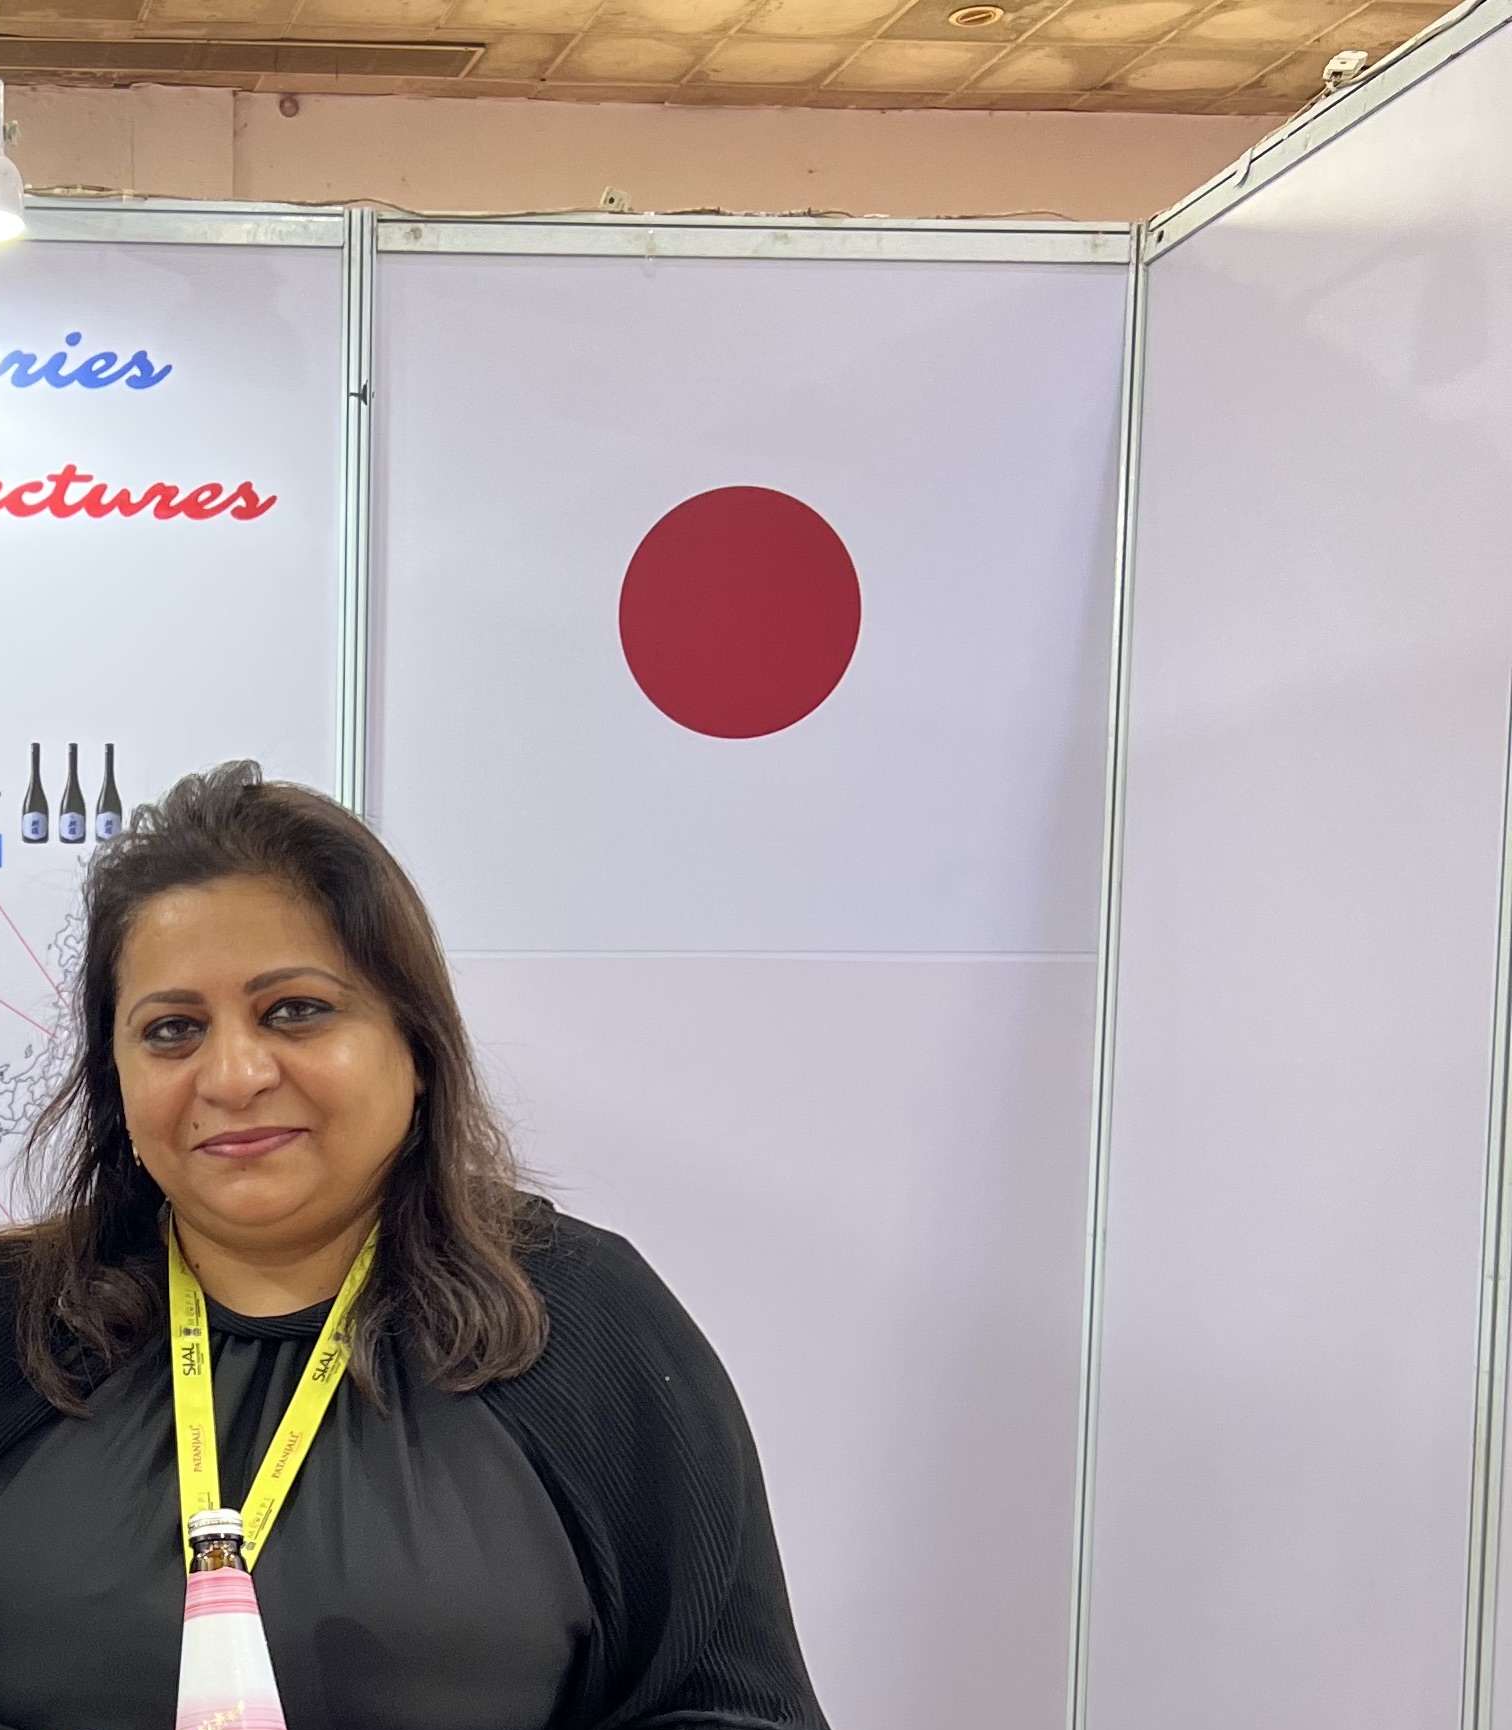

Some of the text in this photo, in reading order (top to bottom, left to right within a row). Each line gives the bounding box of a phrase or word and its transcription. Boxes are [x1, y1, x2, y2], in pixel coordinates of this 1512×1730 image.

[181, 1343, 196, 1376] SIAL
[312, 1349, 338, 1383] SIAL
[193, 1424, 202, 1473] PATANJALI
[272, 1431, 298, 1479] PATANJALI
